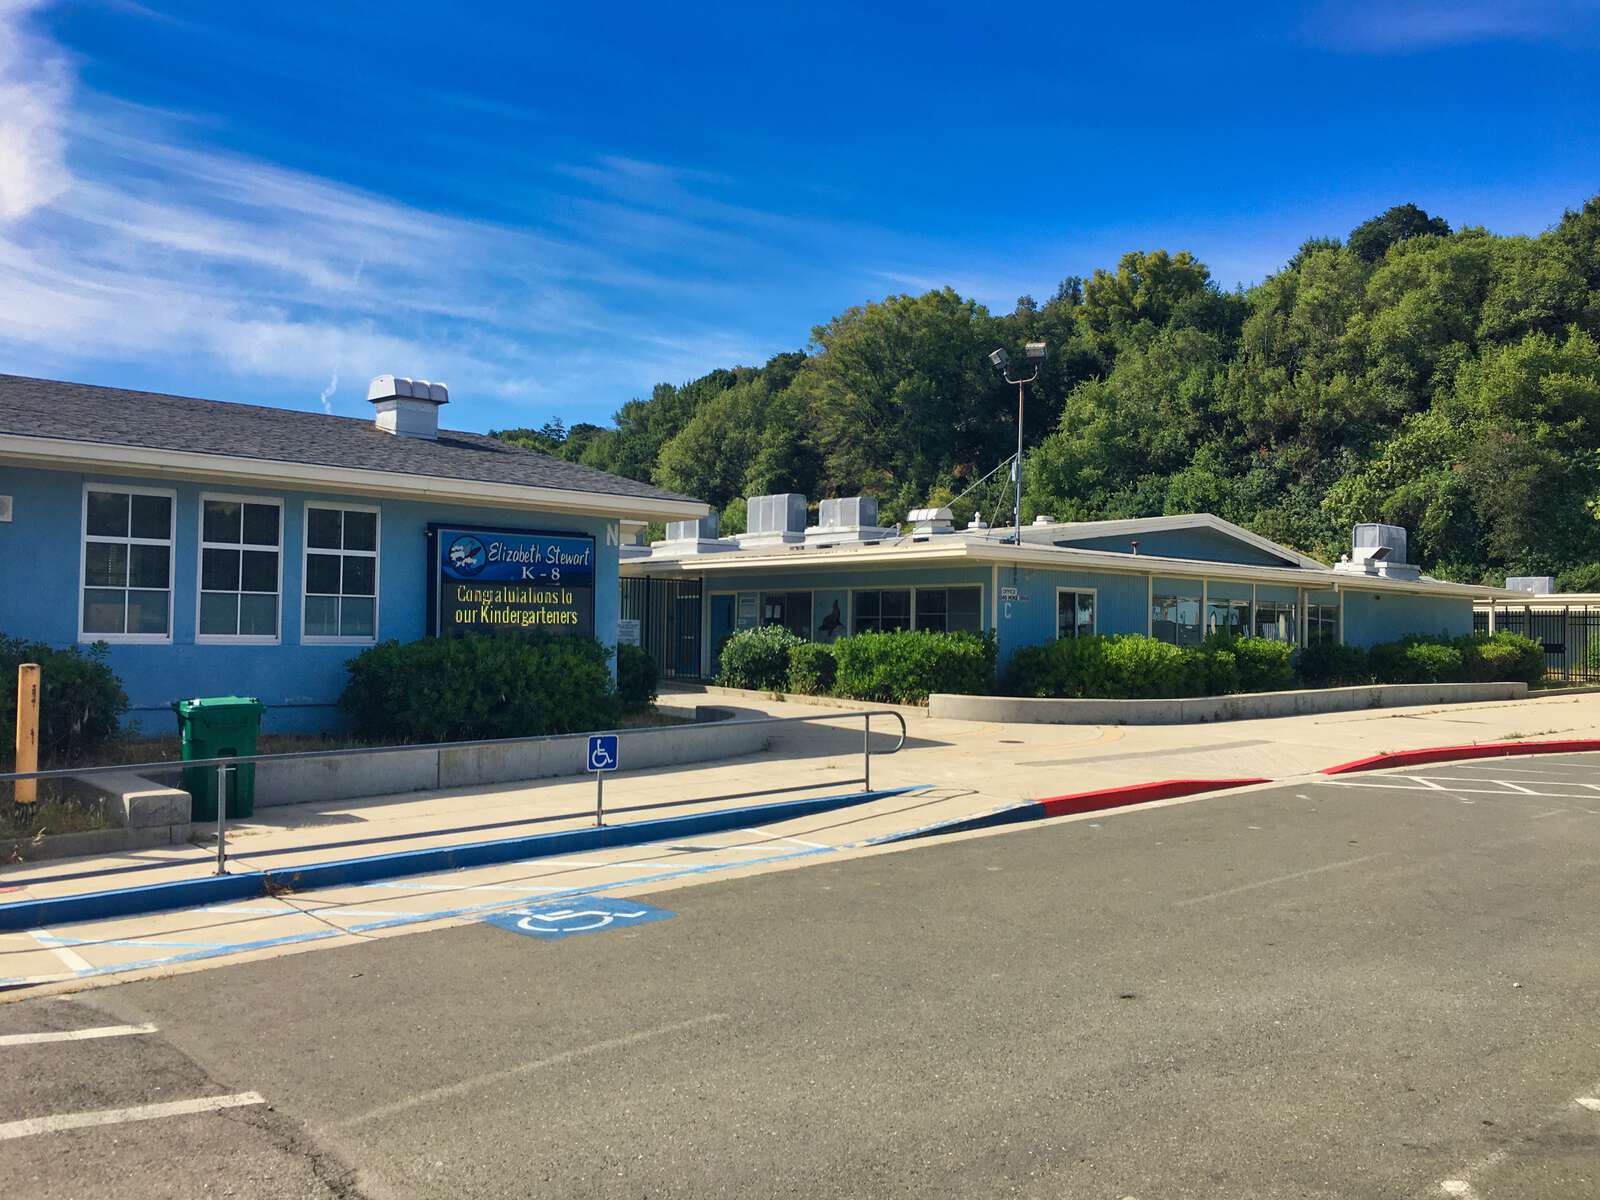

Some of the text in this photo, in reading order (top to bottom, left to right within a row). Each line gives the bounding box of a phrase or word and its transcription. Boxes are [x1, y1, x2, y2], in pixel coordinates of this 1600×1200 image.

[606, 524, 620, 546] N
[488, 542, 590, 566] Elizabeth Stewart
[455, 605, 578, 627] our Kindergarteners
